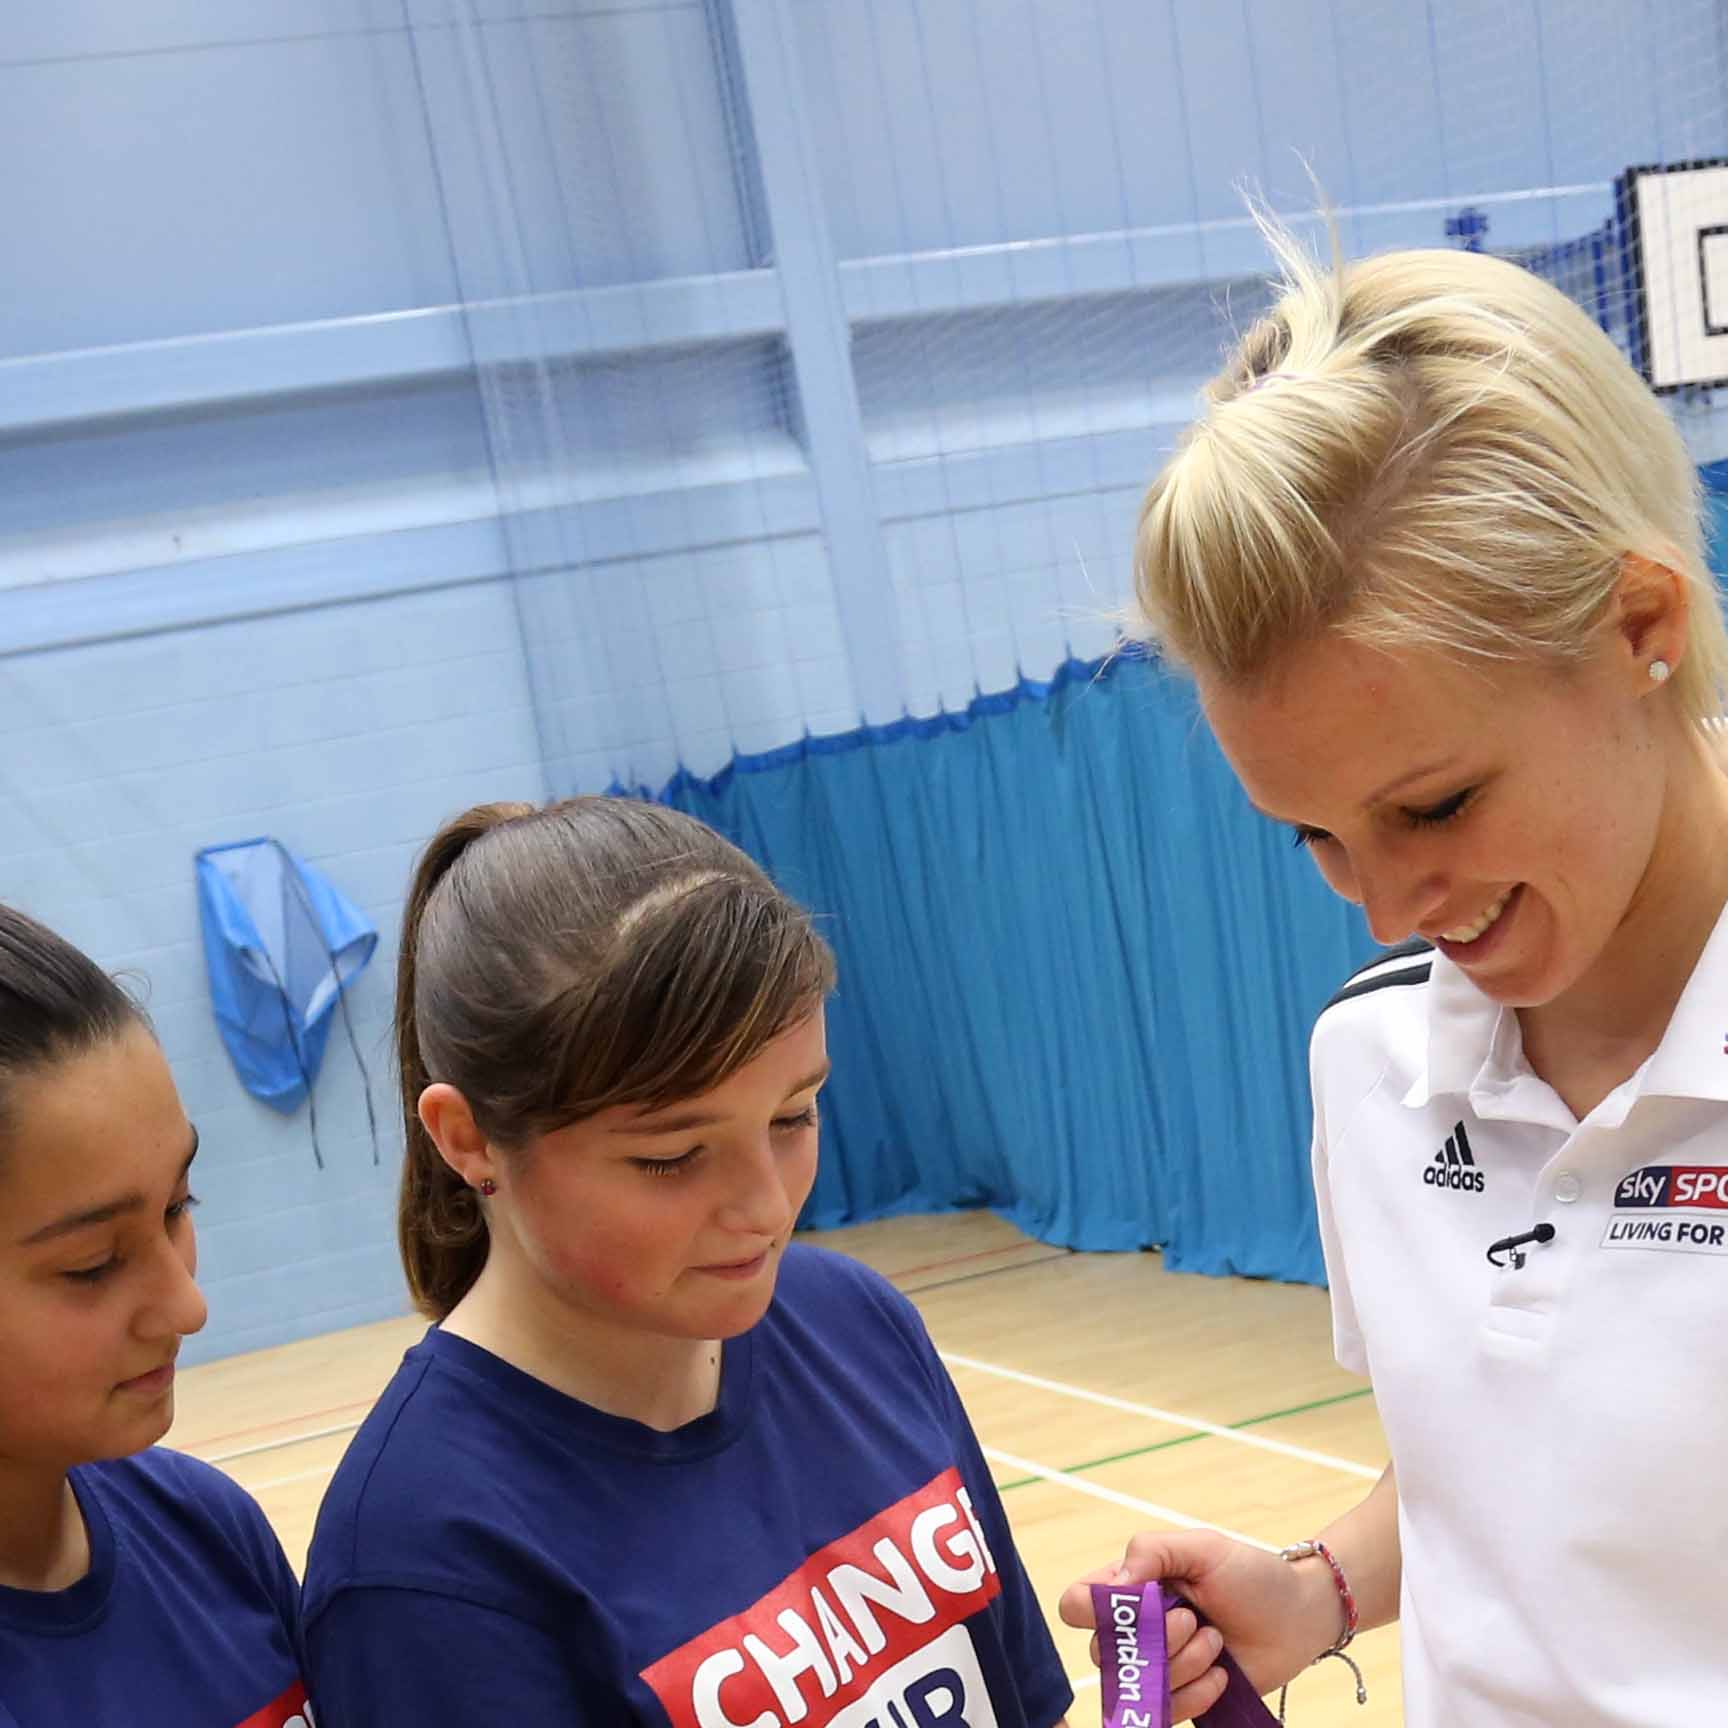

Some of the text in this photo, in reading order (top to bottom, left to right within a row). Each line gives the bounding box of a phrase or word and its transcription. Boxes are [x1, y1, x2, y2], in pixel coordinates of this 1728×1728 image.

[1423, 1162, 1485, 1193] adidas
[1620, 1170, 1666, 1205] sky
[1609, 1221, 1673, 1242] LIVING
[1676, 1222, 1726, 1246] FOR
[1110, 1592, 1149, 1702] London
